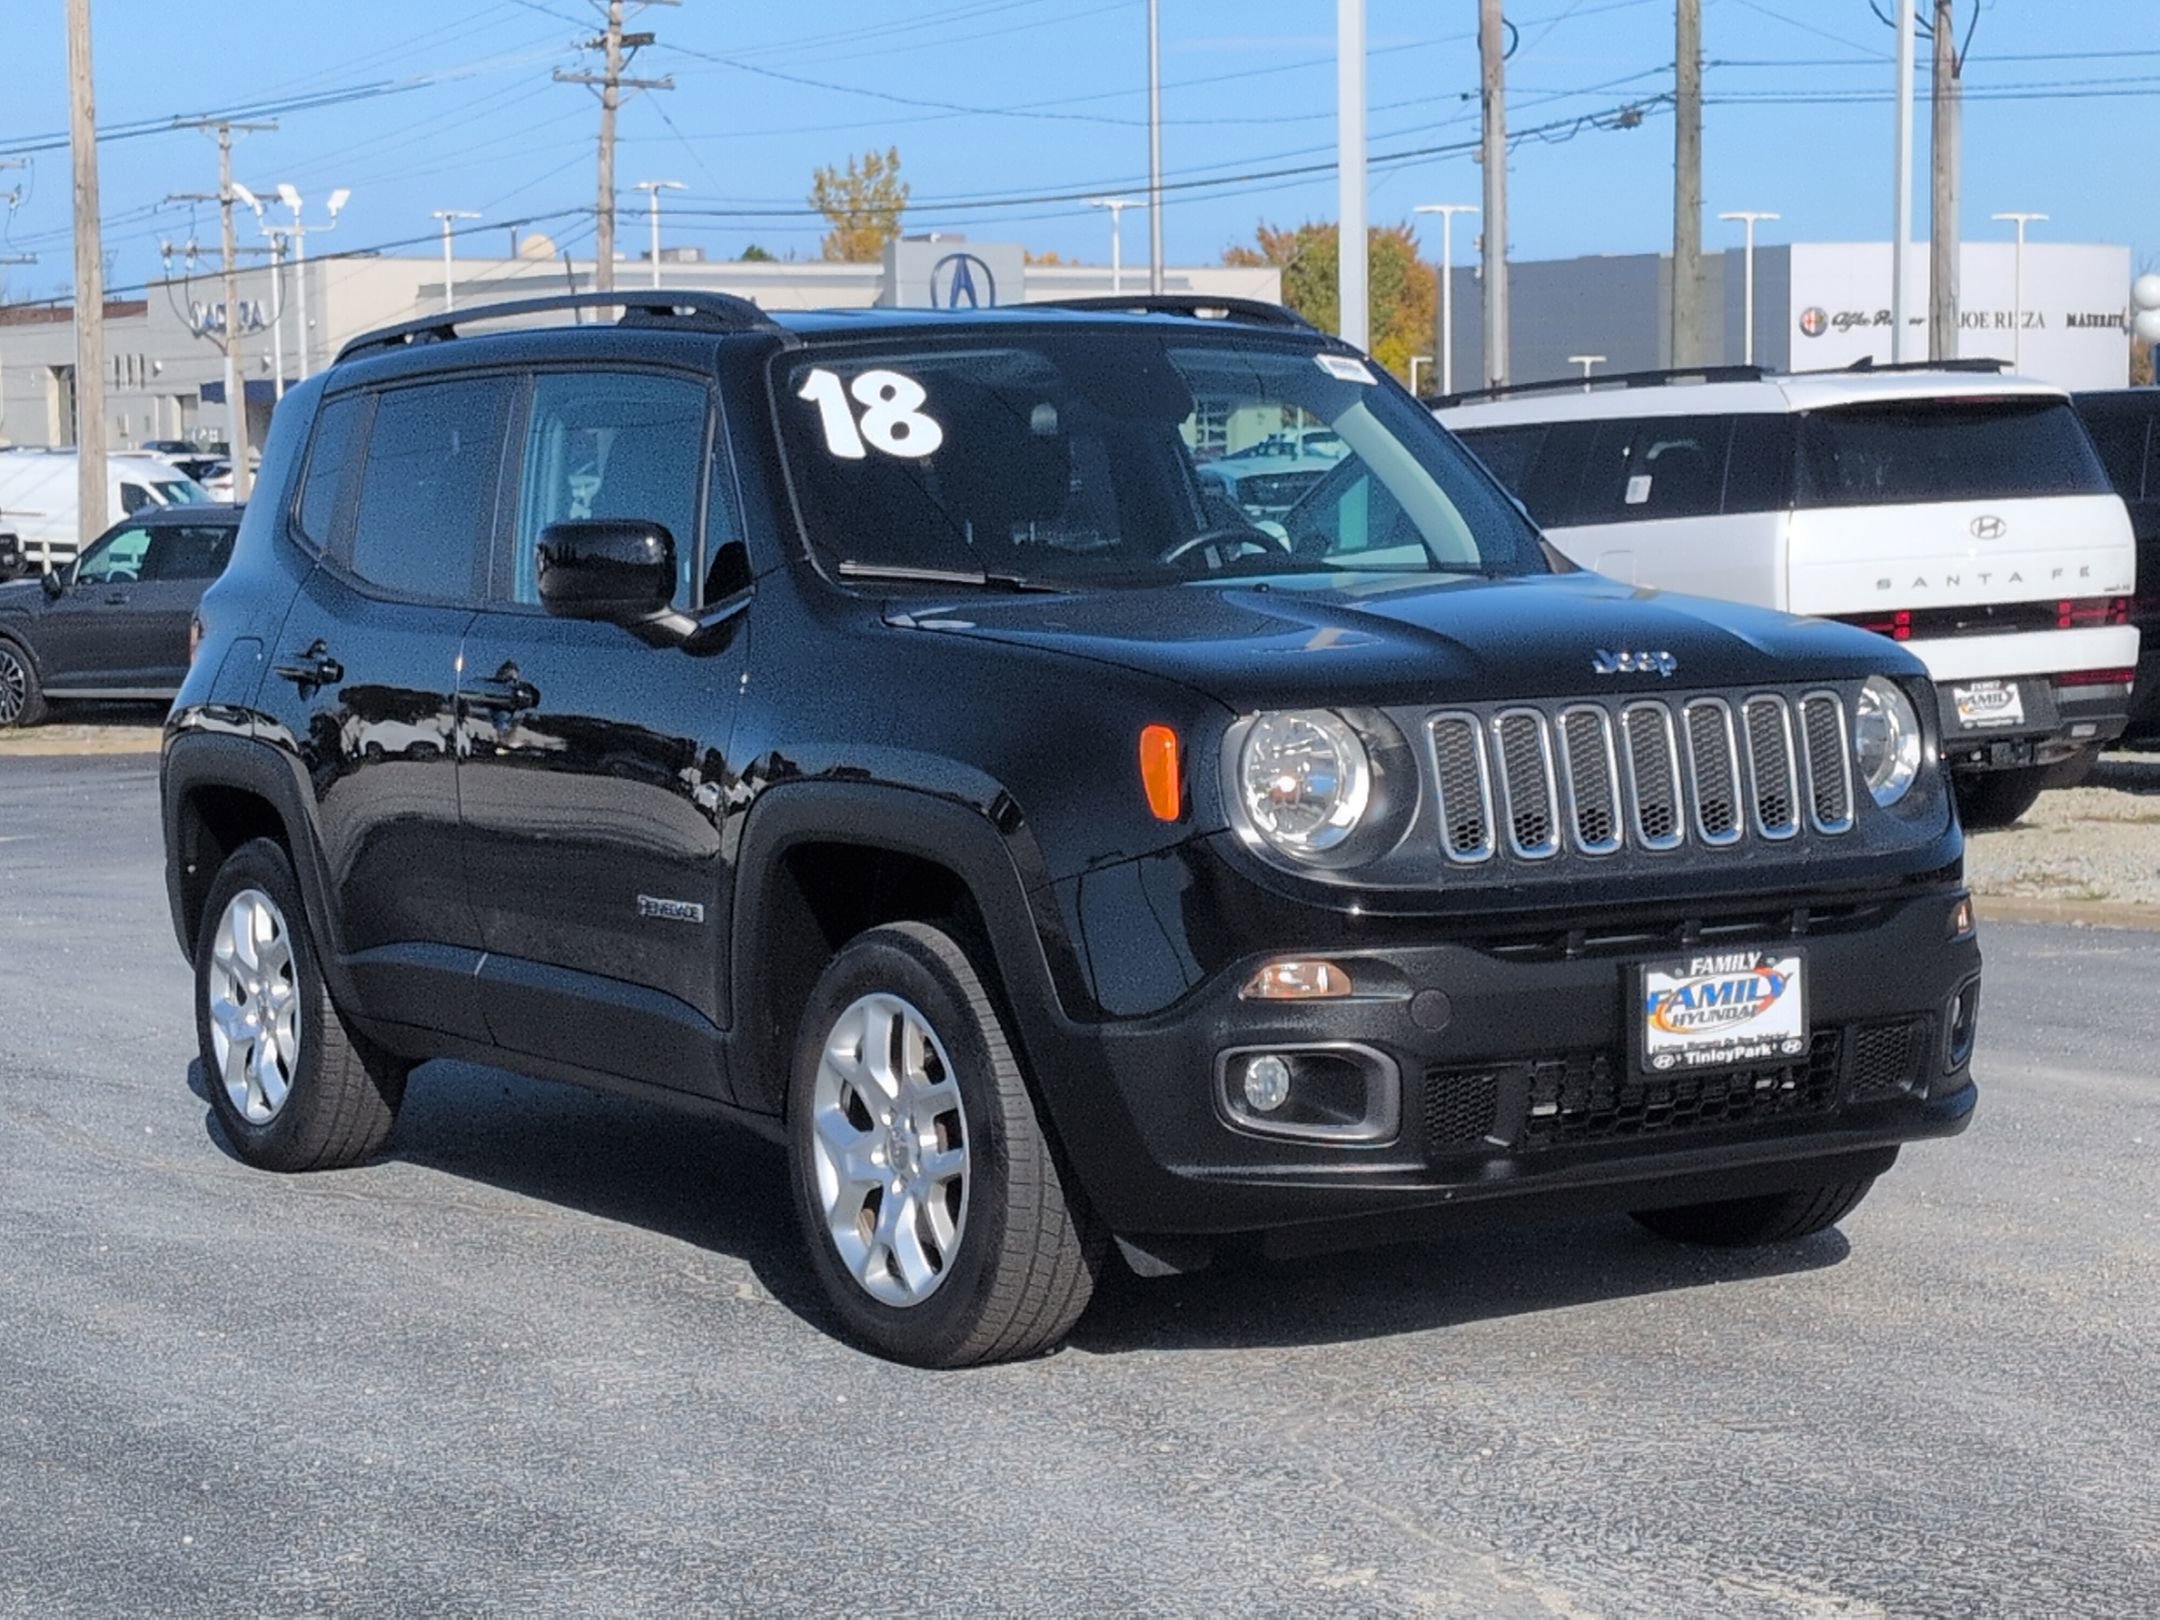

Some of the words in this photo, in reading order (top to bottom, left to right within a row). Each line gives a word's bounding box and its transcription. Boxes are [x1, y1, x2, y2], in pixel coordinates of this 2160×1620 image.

[1831, 310, 1871, 333] Alfa
[1959, 311, 1989, 329] JOE
[797, 368, 943, 460] 18
[1876, 571, 2023, 590] SANTA
[2051, 565, 2091, 581] FE
[1592, 649, 1678, 678] Jeep
[1691, 952, 1762, 975] FAMILY
[1645, 972, 1793, 1014] FAMILY
[1672, 1003, 1761, 1028] HYUNDAI
